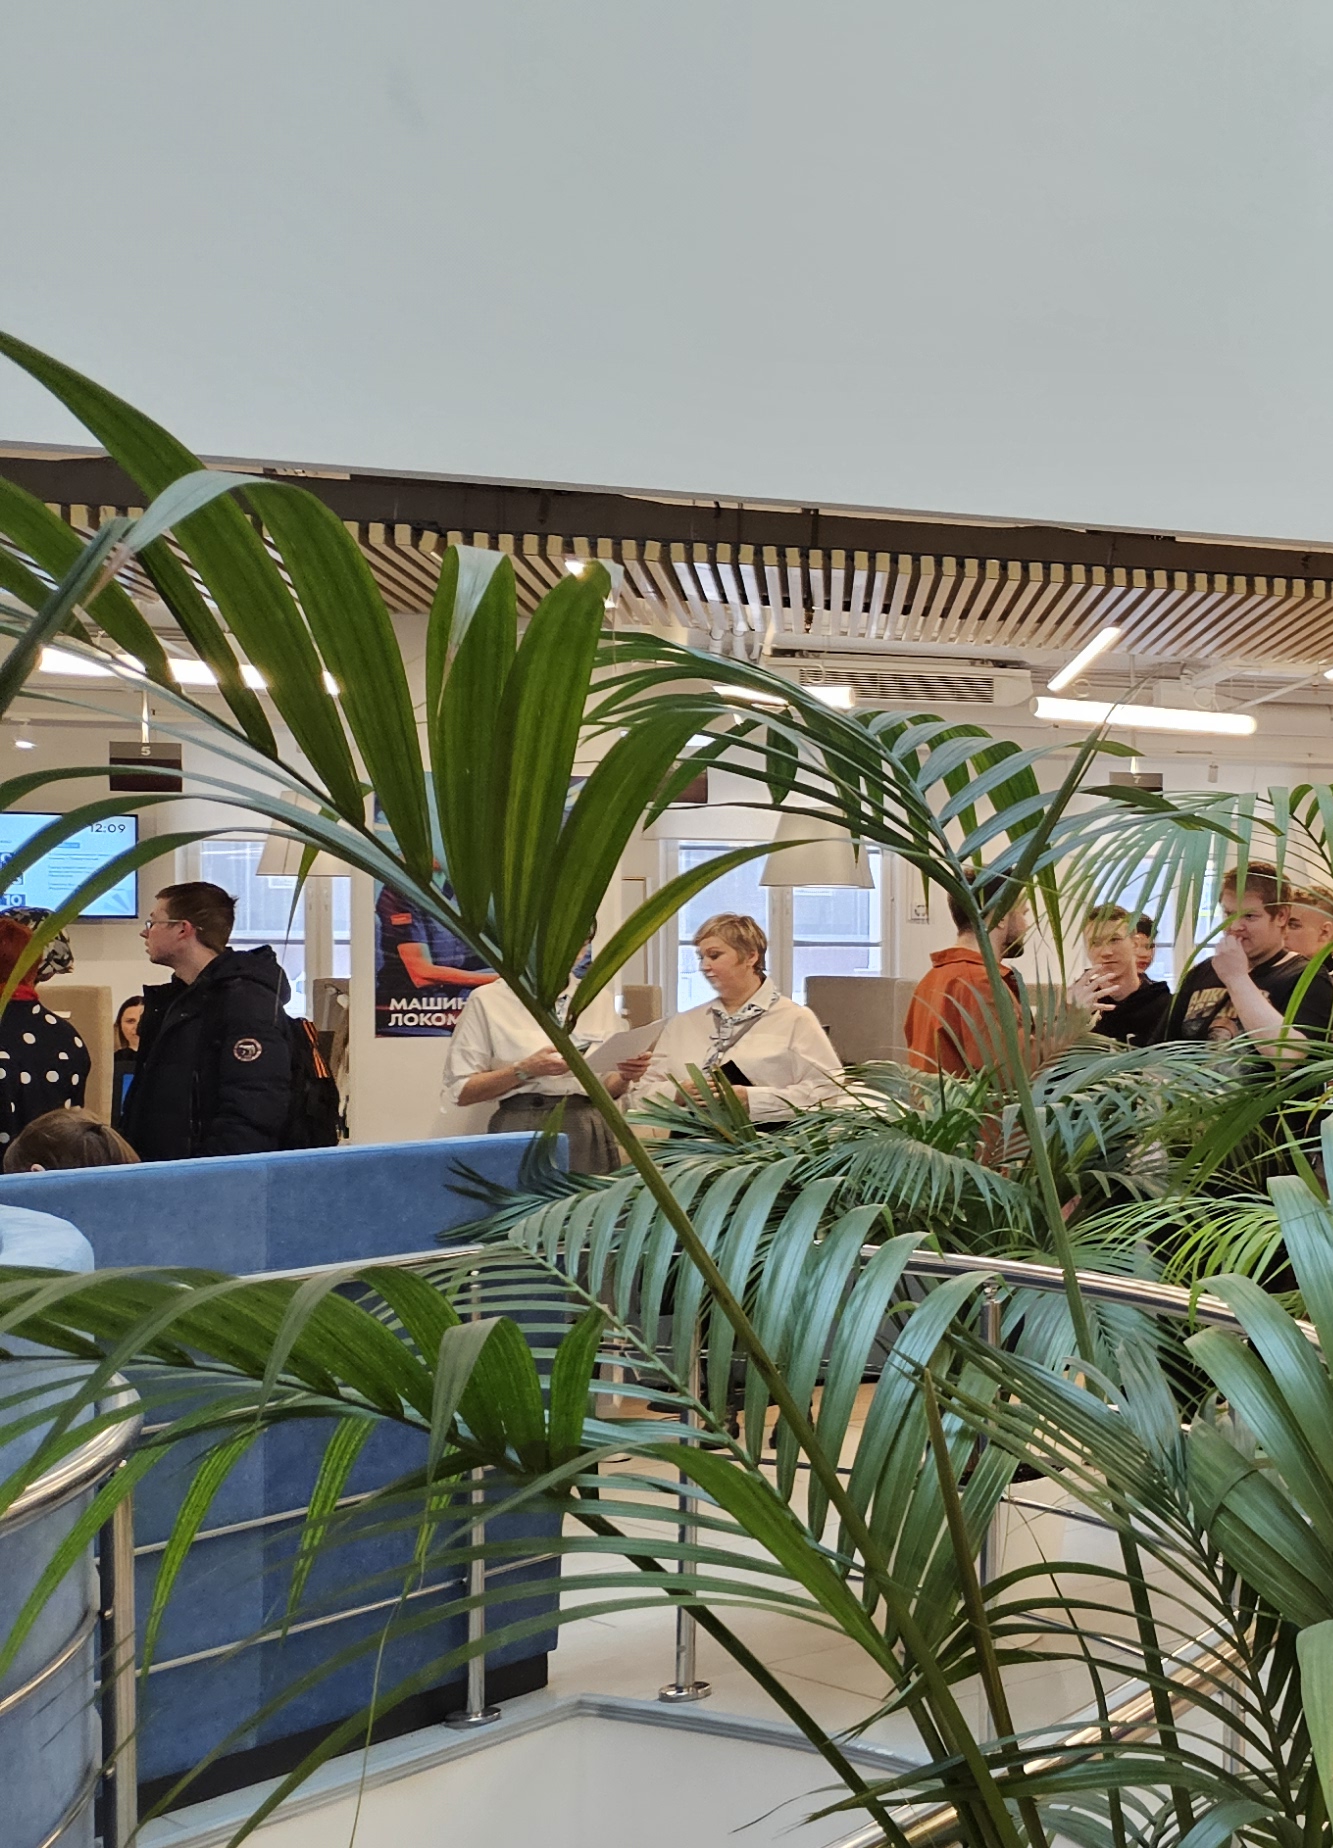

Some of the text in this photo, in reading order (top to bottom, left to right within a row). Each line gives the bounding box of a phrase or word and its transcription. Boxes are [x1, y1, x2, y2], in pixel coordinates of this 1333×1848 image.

[141, 746, 151, 756] 5
[1133, 776, 1141, 784] 7
[90, 823, 126, 833] 12:09
